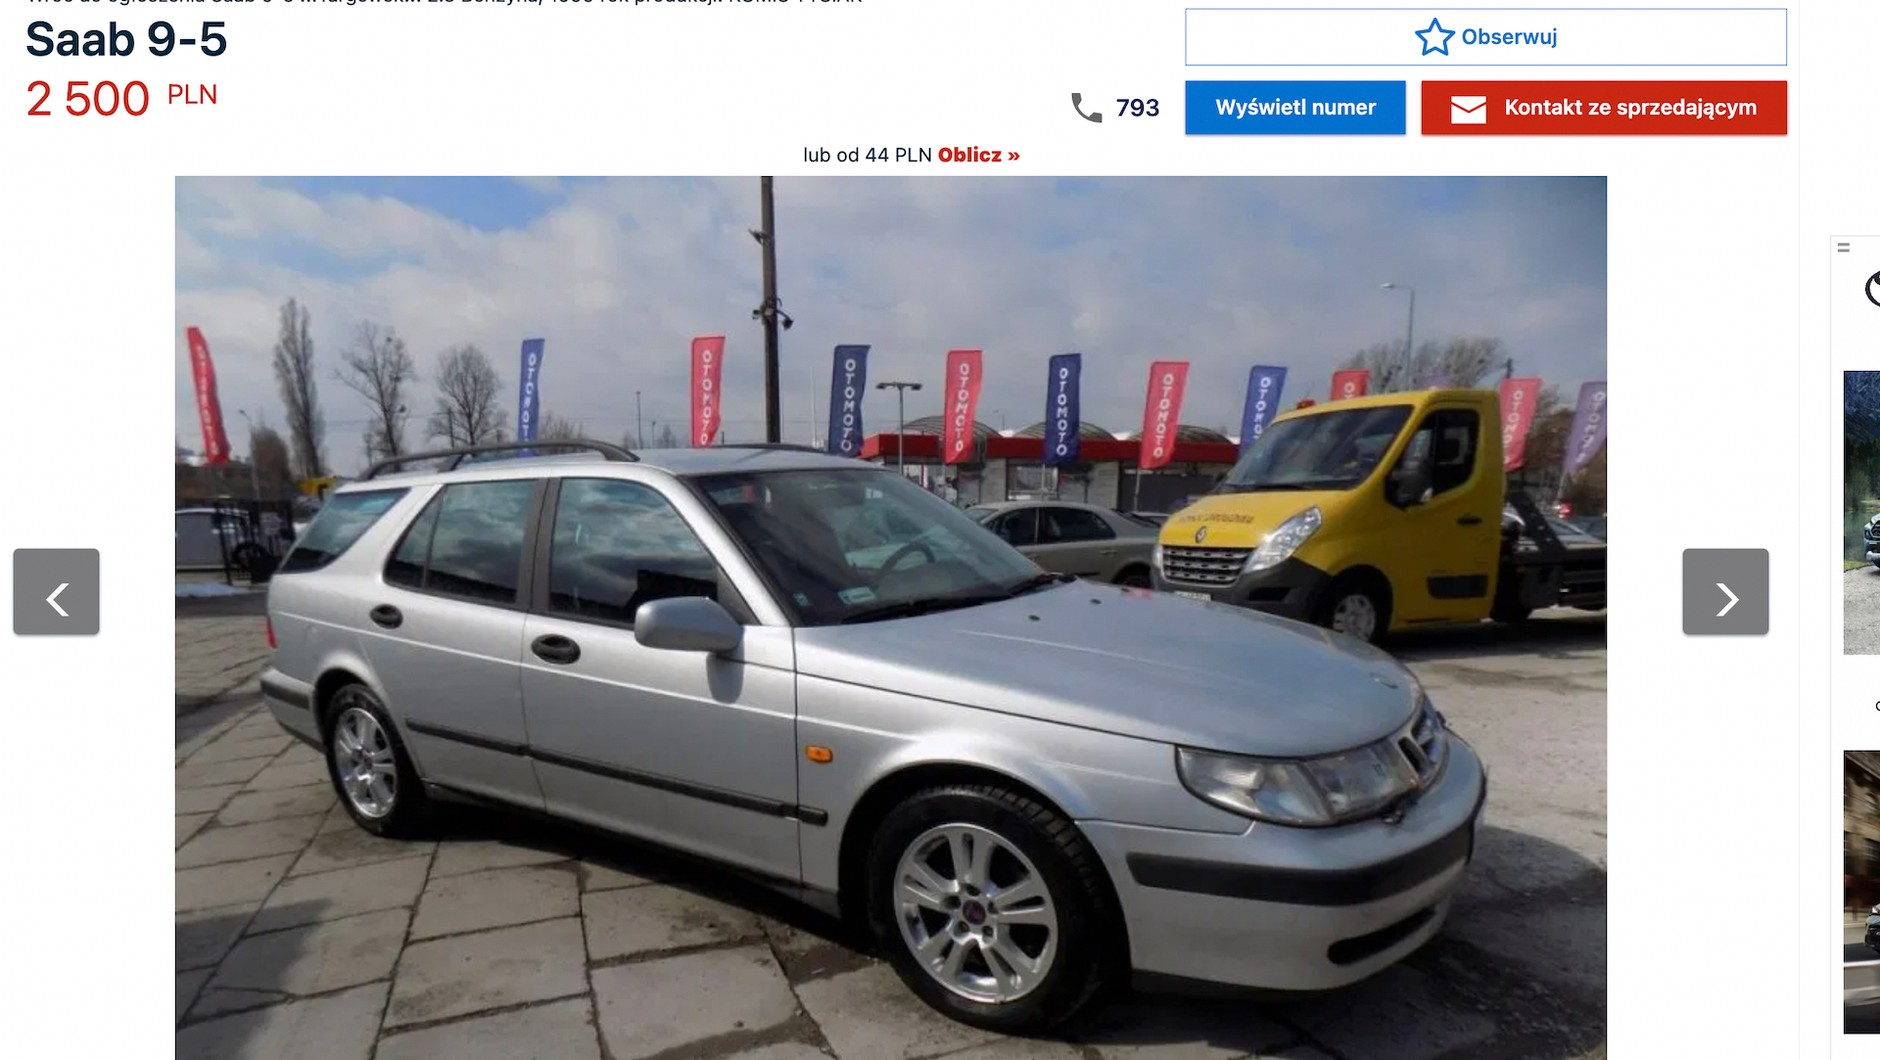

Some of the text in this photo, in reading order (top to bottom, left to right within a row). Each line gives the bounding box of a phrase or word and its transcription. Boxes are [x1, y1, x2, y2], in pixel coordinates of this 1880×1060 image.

[25, 20, 228, 58] Saab 9-5
[1462, 27, 1558, 49] Obserwuj
[26, 79, 217, 117] 2 500 PLN
[1115, 97, 1160, 118] 793
[1215, 97, 1378, 120] Wyświetl numer
[1505, 97, 1758, 121] Kontakt ze sprzedającym
[803, 146, 832, 163] lub
[836, 146, 860, 163] od
[864, 146, 890, 163] 44
[895, 146, 932, 163] PLN
[937, 145, 1003, 163] Oblicz
[700, 349, 713, 445] OTOMOTO
[840, 358, 856, 451] OTOMOTO
[954, 362, 970, 452] OTOMOTO
[1056, 367, 1069, 456] OTOMOTO
[1152, 373, 1175, 458] OTOMOTO
